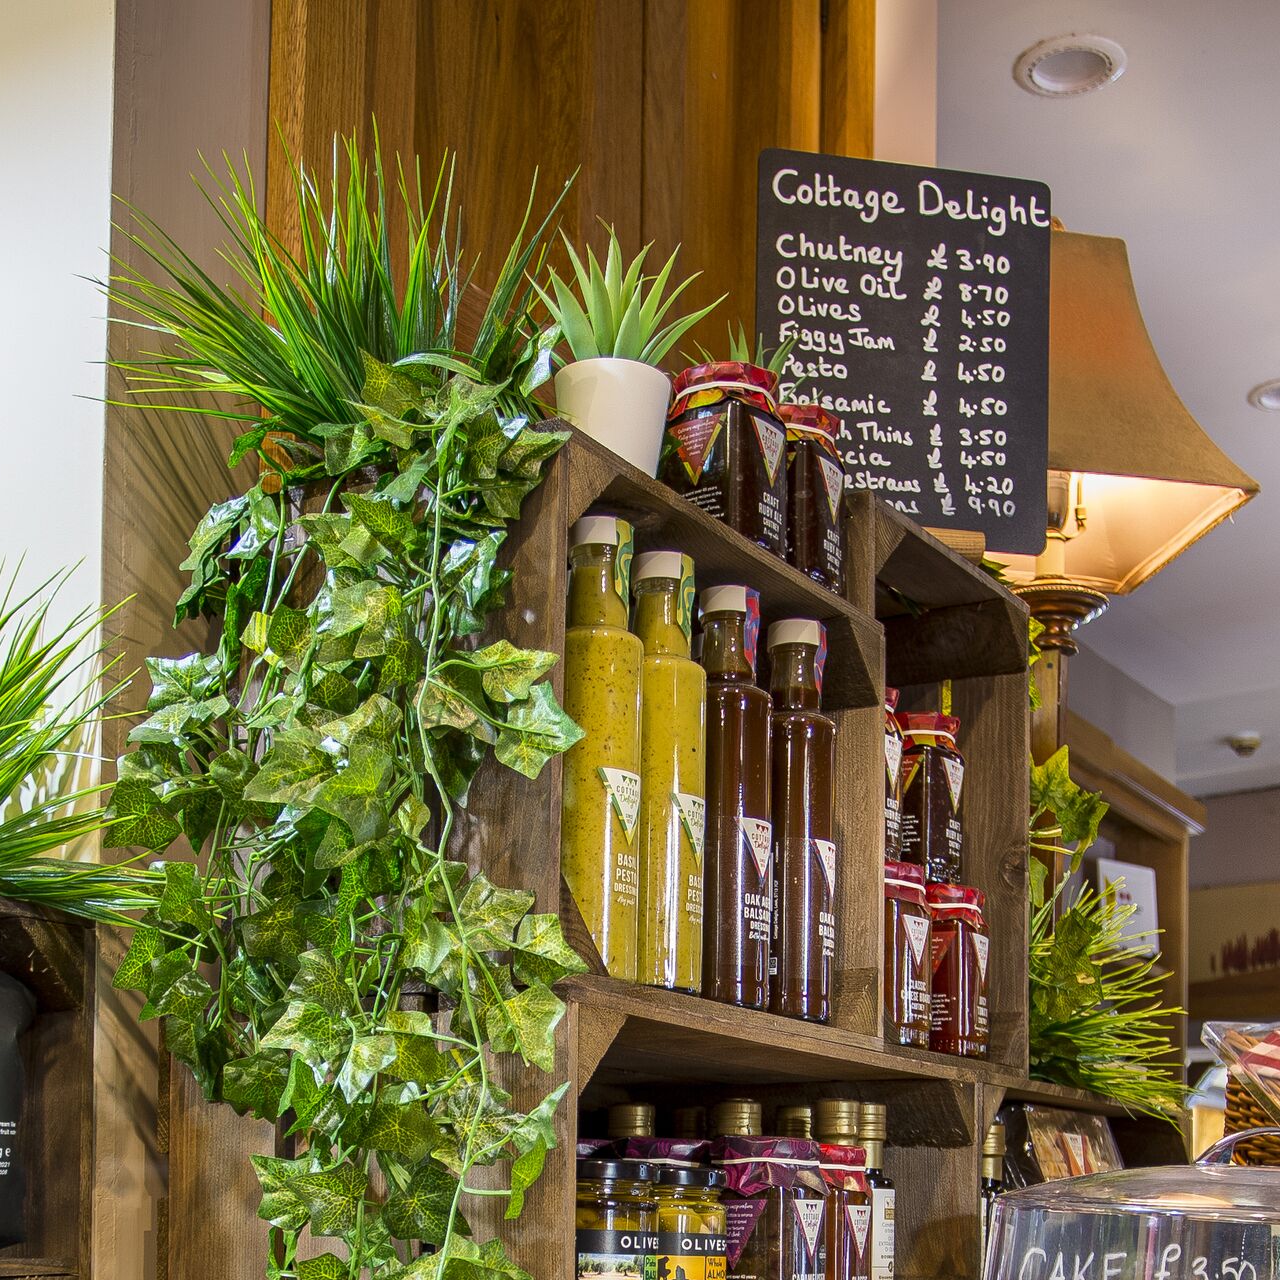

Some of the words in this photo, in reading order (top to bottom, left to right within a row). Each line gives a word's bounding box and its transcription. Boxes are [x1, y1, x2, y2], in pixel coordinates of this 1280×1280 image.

[772, 168, 905, 223] Cottage
[918, 180, 1050, 236] Delight
[776, 233, 903, 282] Chutney
[776, 266, 850, 295] Olive
[860, 273, 908, 300] Oil
[777, 294, 862, 323] Olives
[778, 320, 846, 356] Figgy
[847, 326, 896, 352] Jam
[782, 353, 849, 380] Pesto
[777, 382, 892, 415] Balsamic
[852, 420, 914, 447] Thins
[844, 470, 922, 494] estraws
[681, 1238, 726, 1252] OLIVES
